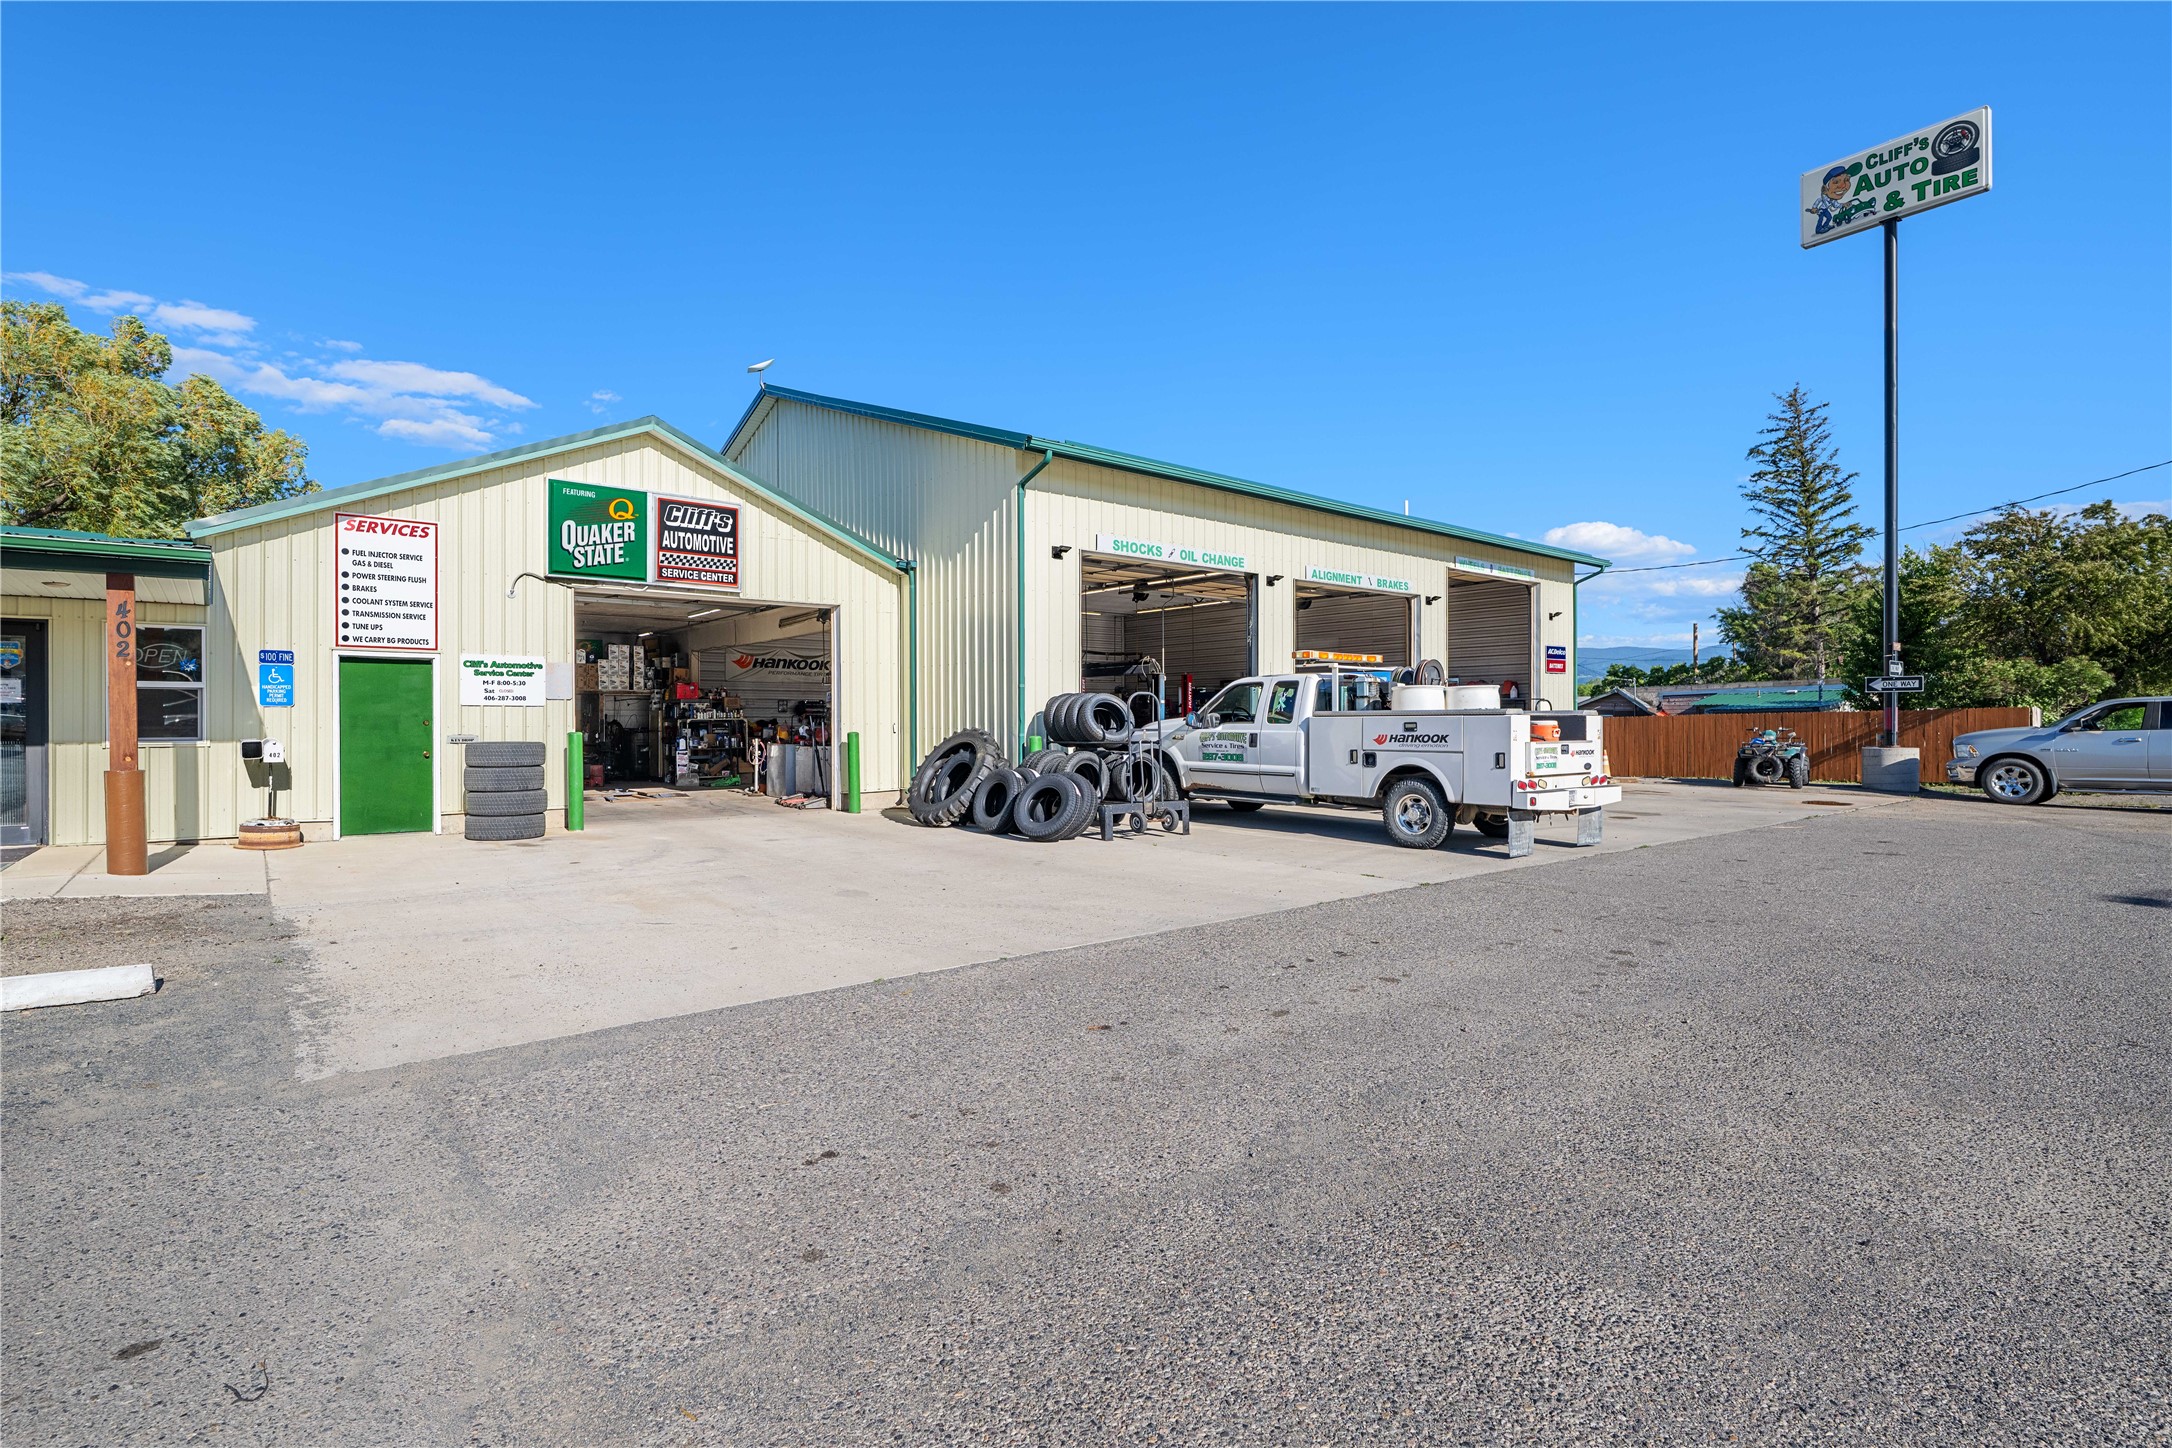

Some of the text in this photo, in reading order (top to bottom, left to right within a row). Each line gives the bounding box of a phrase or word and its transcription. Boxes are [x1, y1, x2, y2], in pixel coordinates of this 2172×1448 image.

[1866, 137, 1930, 169] CLIFF'S
[1853, 157, 1929, 196] AUTO
[1884, 168, 1978, 211] & TIRE
[563, 488, 596, 498] FEATURING
[609, 498, 636, 520] Q
[664, 505, 732, 533] Cliff's
[344, 519, 430, 539] SERVICES
[561, 520, 635, 554] QUAKER
[662, 530, 733, 554] AUTOMOTIVE
[368, 551, 397, 559] INJECTOR
[399, 553, 423, 561] SERVICE
[573, 543, 625, 569] STATE
[1112, 539, 1245, 568] SHOCKS OIL CHANGE
[378, 574, 406, 582] STEERING
[662, 568, 734, 583] SERVICE CENTER
[1312, 569, 1409, 591] ALIGNMENT BRAKES
[352, 598, 383, 606] COOLANT
[352, 610, 426, 620] TRANSMISSION SERVICE
[116, 600, 131, 658] 402
[490, 661, 543, 670] Automotive
